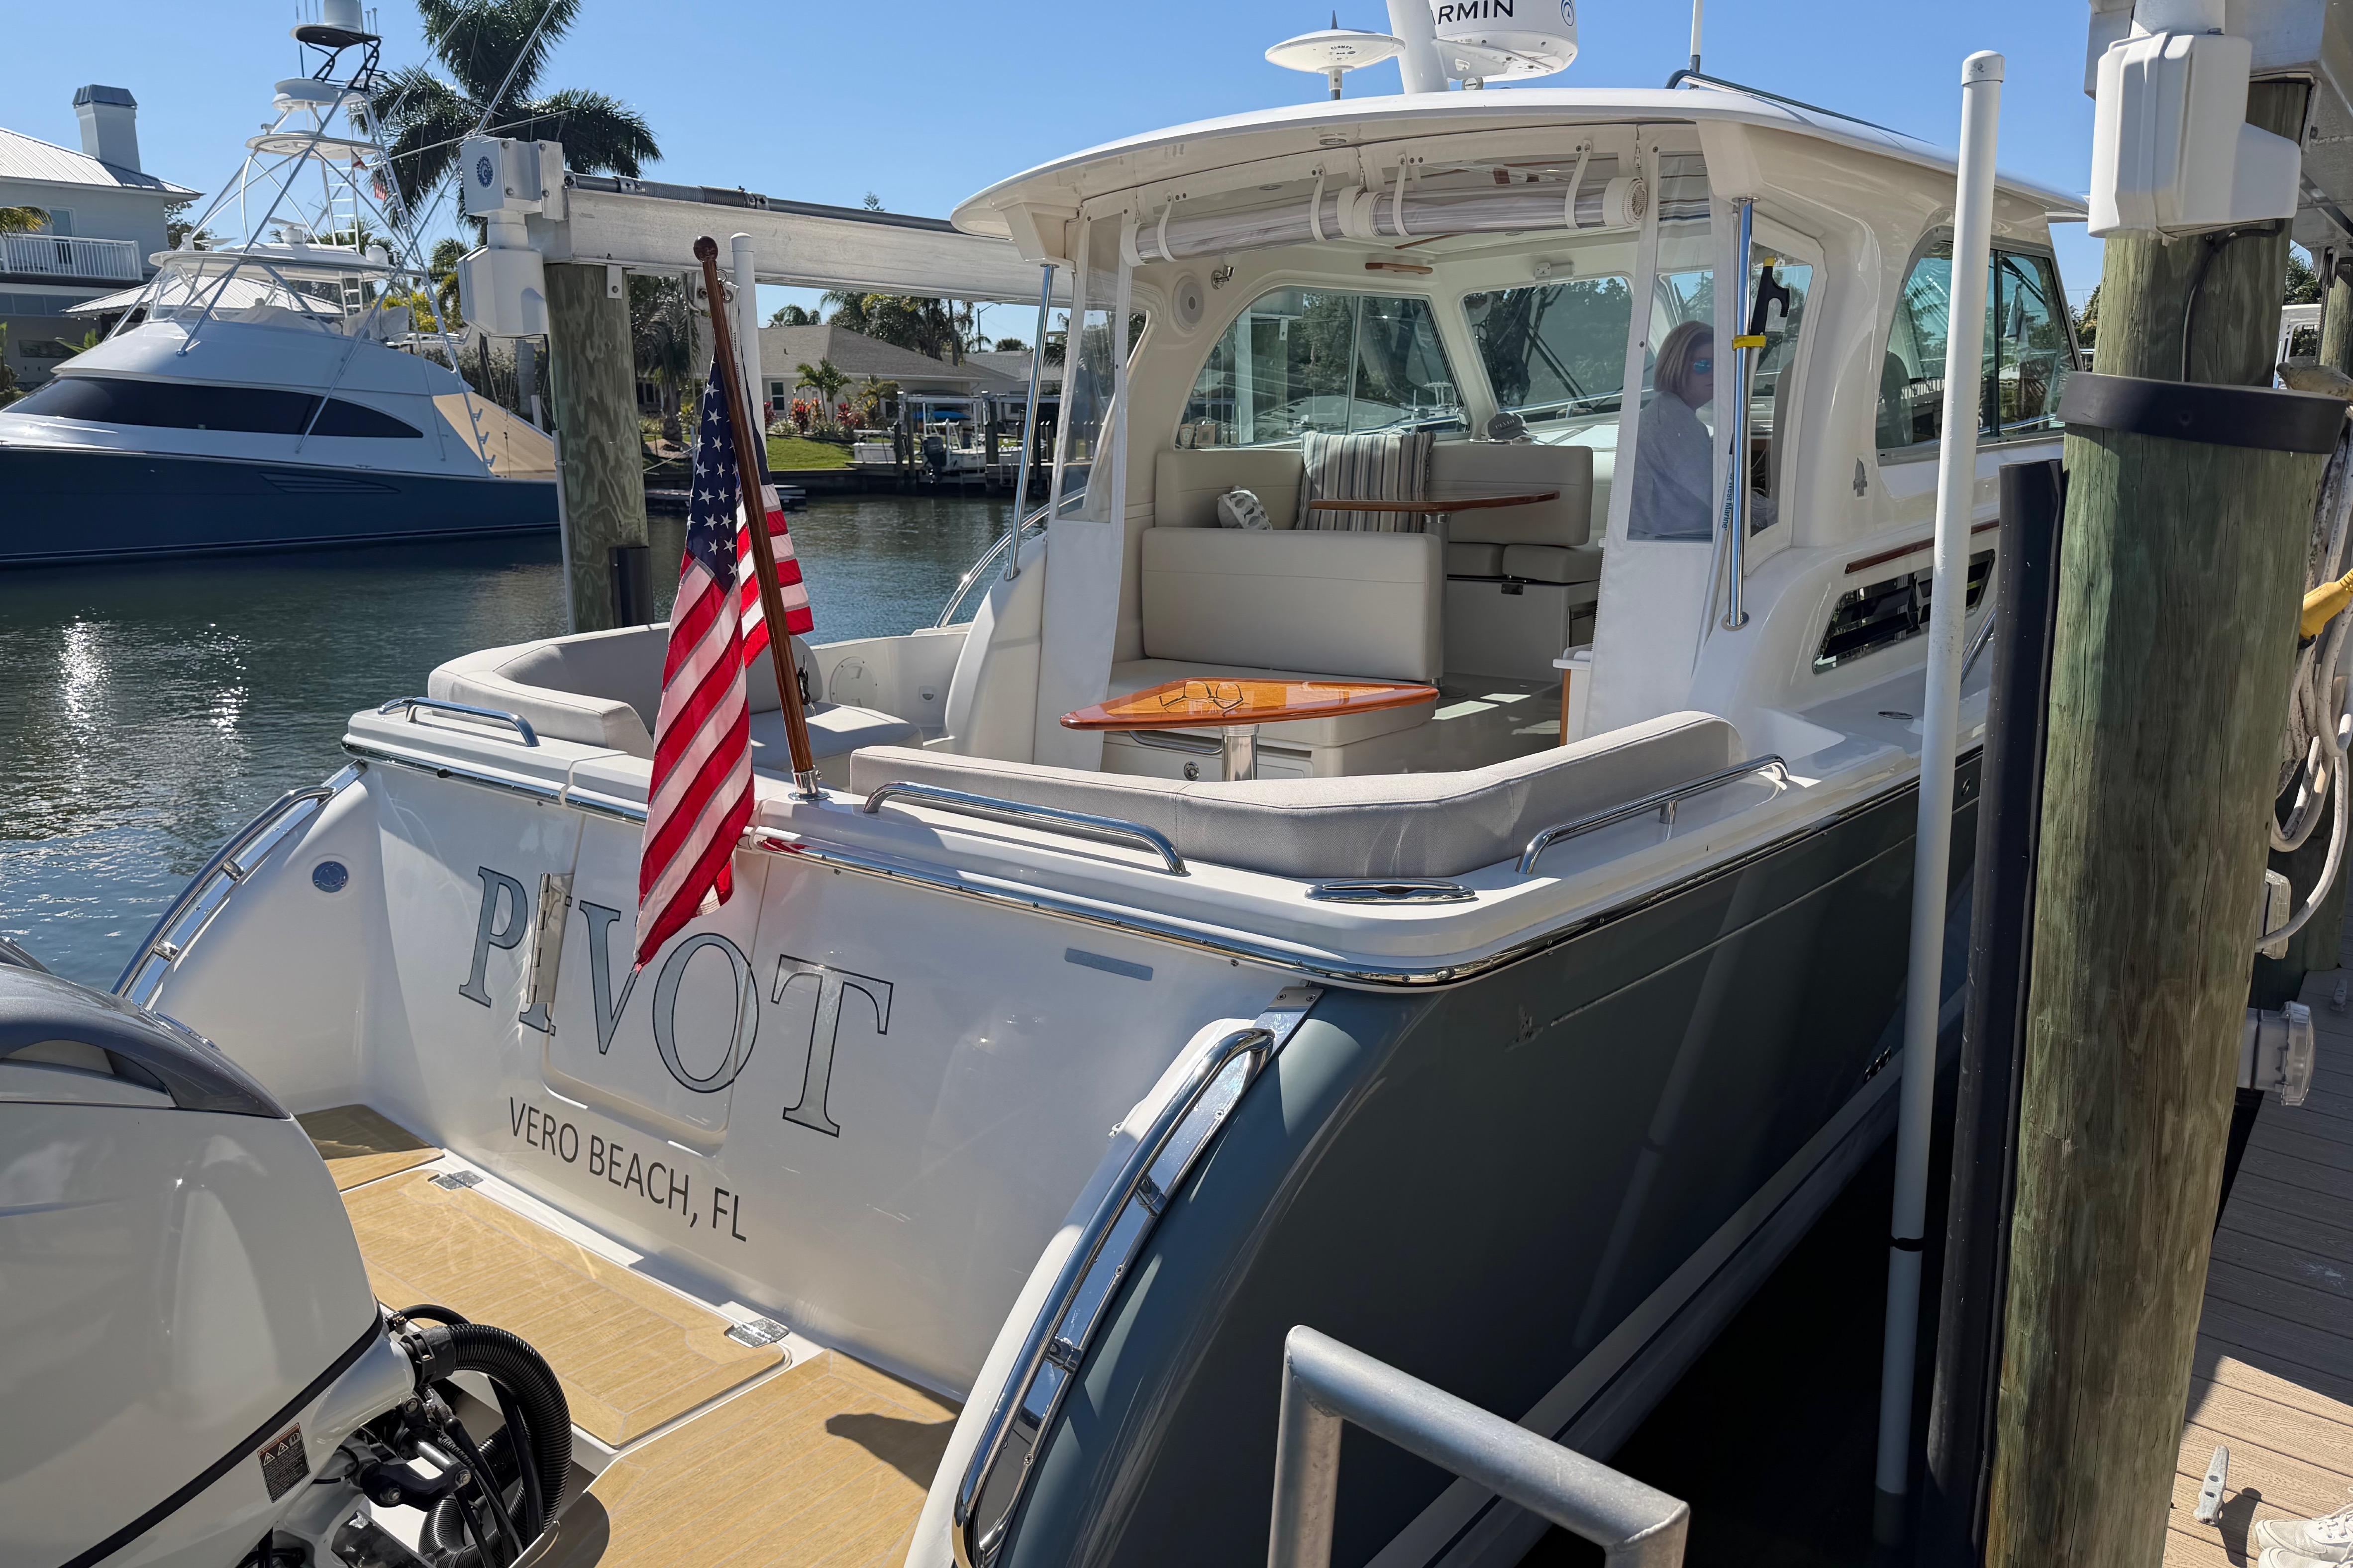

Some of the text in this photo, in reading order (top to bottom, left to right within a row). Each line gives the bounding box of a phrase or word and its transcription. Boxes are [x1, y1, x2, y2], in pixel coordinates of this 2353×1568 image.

[1431, 0, 1513, 25] RMIN
[1722, 502, 1732, 529] Marine
[459, 866, 894, 1138] PVOT
[510, 1096, 746, 1242] VERO BEACH, FL
